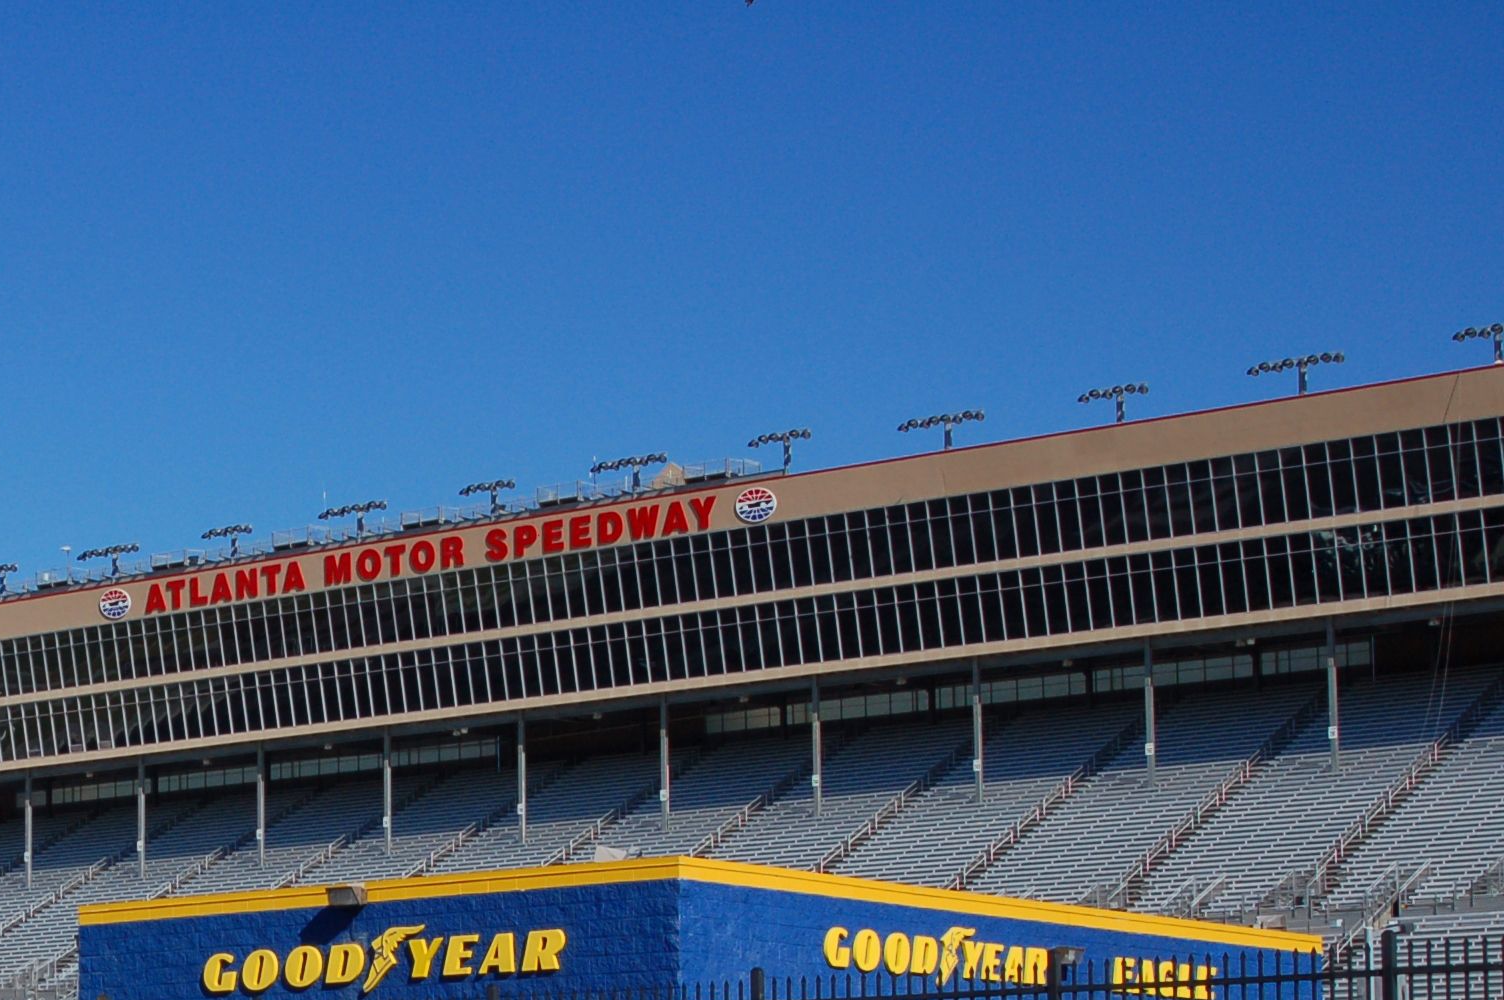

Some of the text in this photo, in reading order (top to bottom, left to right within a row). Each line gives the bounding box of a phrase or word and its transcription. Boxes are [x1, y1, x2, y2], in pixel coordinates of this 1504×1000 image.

[145, 496, 716, 615] ATLANTA MOTOR SPEEDWAY
[1111, 956, 1217, 1000] EAGLE
